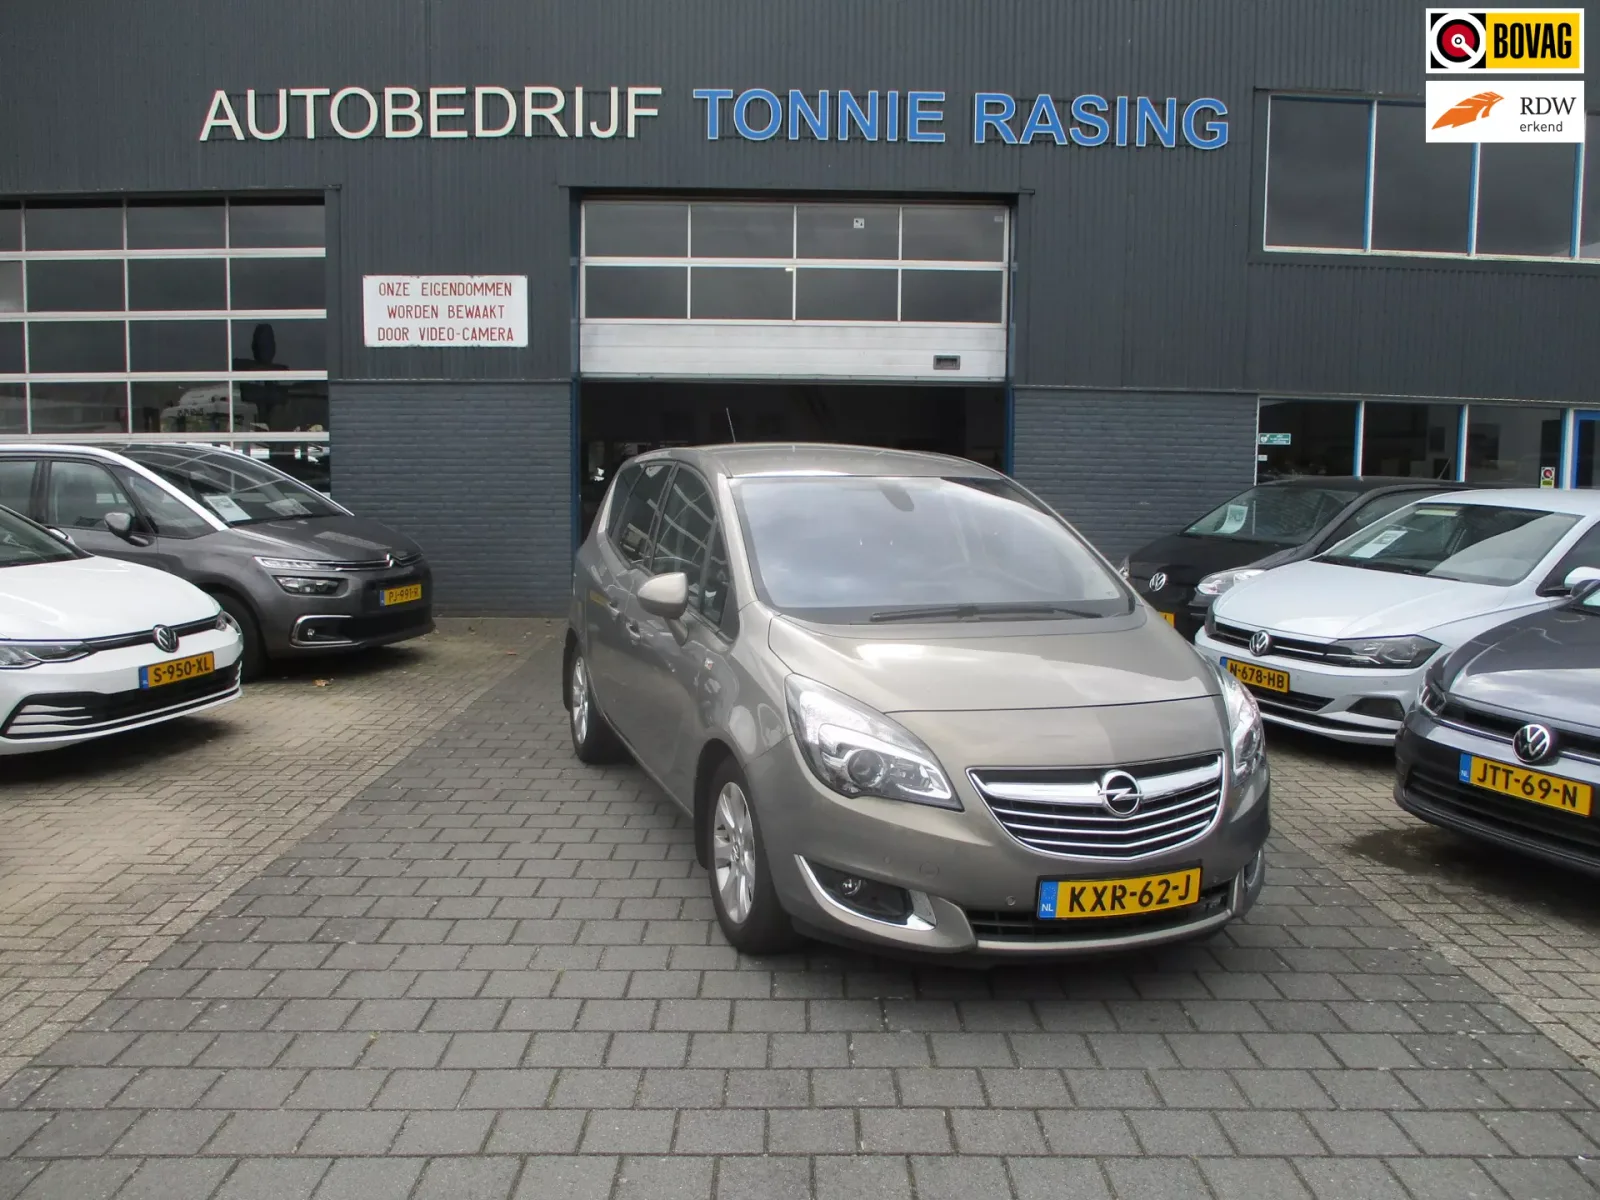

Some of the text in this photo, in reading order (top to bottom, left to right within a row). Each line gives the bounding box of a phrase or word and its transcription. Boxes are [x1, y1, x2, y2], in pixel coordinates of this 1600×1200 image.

[199, 86, 1230, 150] AUTOBEDRIJF TONNIE RASING
[378, 282, 512, 297] ONZE EIGENDOMMEN
[387, 304, 506, 319] WORDEN BEWAAKT
[378, 327, 514, 342] DOOR VIDEO-CAMERA
[153, 656, 211, 683] S-950-XL
[1229, 662, 1285, 689] N-678-HB
[1477, 763, 1578, 808] JTT-69-N
[1041, 874, 1191, 913] NL KXR-62-J
